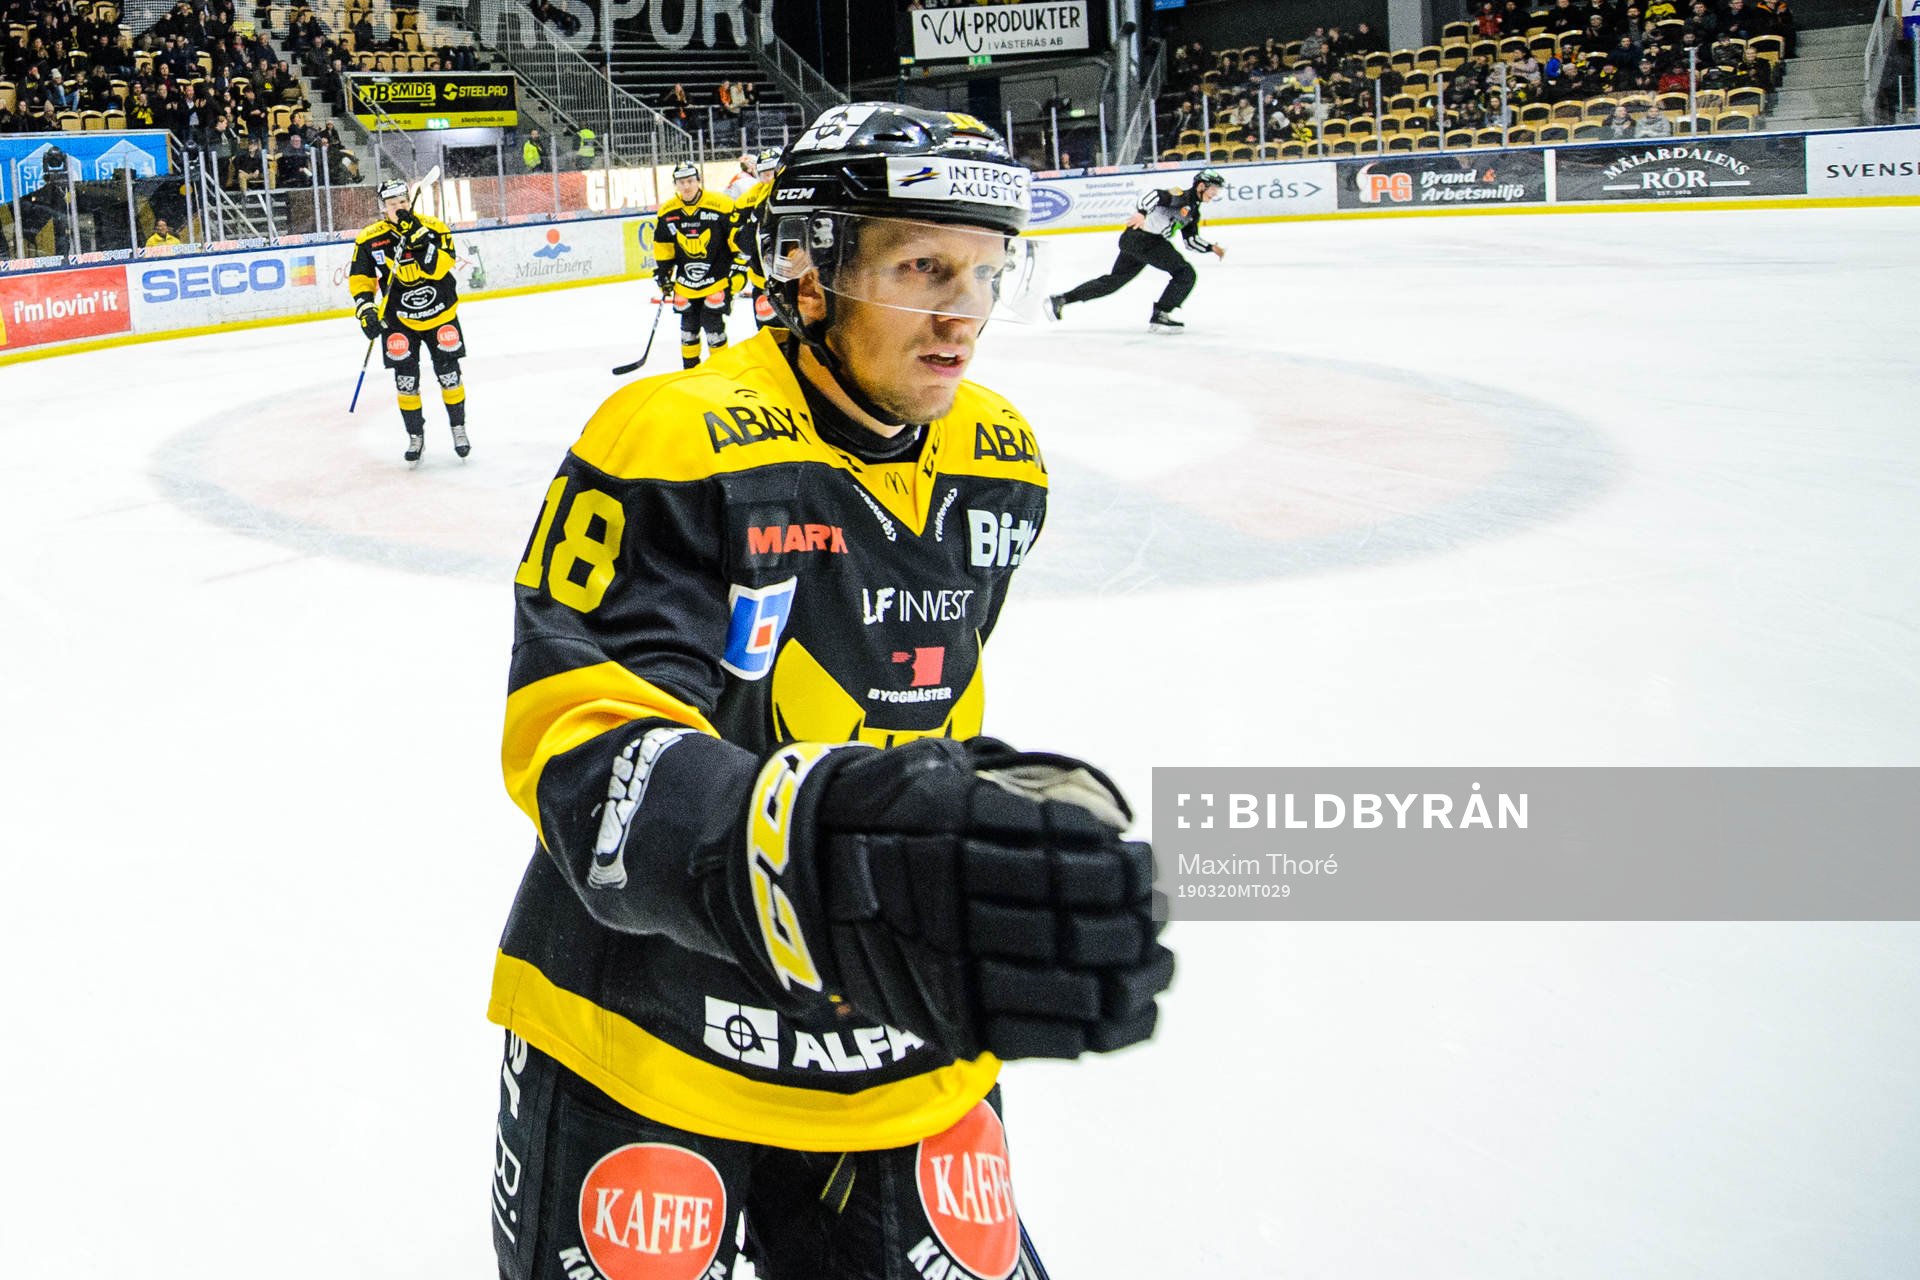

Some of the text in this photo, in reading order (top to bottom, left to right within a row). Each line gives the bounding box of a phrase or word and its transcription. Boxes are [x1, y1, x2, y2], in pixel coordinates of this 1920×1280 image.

[994, 37, 1047, 49] VÄSTERÅS
[1050, 36, 1063, 46] AB
[391, 82, 432, 97] SMIDE
[458, 85, 508, 98] STEELPRO
[1602, 147, 1750, 181] MÄLARDALENS
[1826, 161, 1920, 179] SVENS
[948, 165, 1022, 189] INTEROC
[1368, 172, 1413, 202] PG
[1420, 168, 1497, 186] Brand &
[1640, 167, 1709, 190] RÖR
[775, 187, 816, 201] CCM
[949, 182, 1021, 202] AKUSTIK
[1421, 184, 1525, 202] Arbetsmiljö
[516, 257, 593, 279] MälarEnergi
[142, 259, 286, 304] SECO
[47, 290, 99, 319] lovin'
[102, 290, 118, 311] it
[514, 476, 626, 614] 18
[862, 586, 974, 625] LF INVEST
[868, 687, 952, 704] BYGGMÄSTER
[592, 1188, 713, 1255] KAFFE
